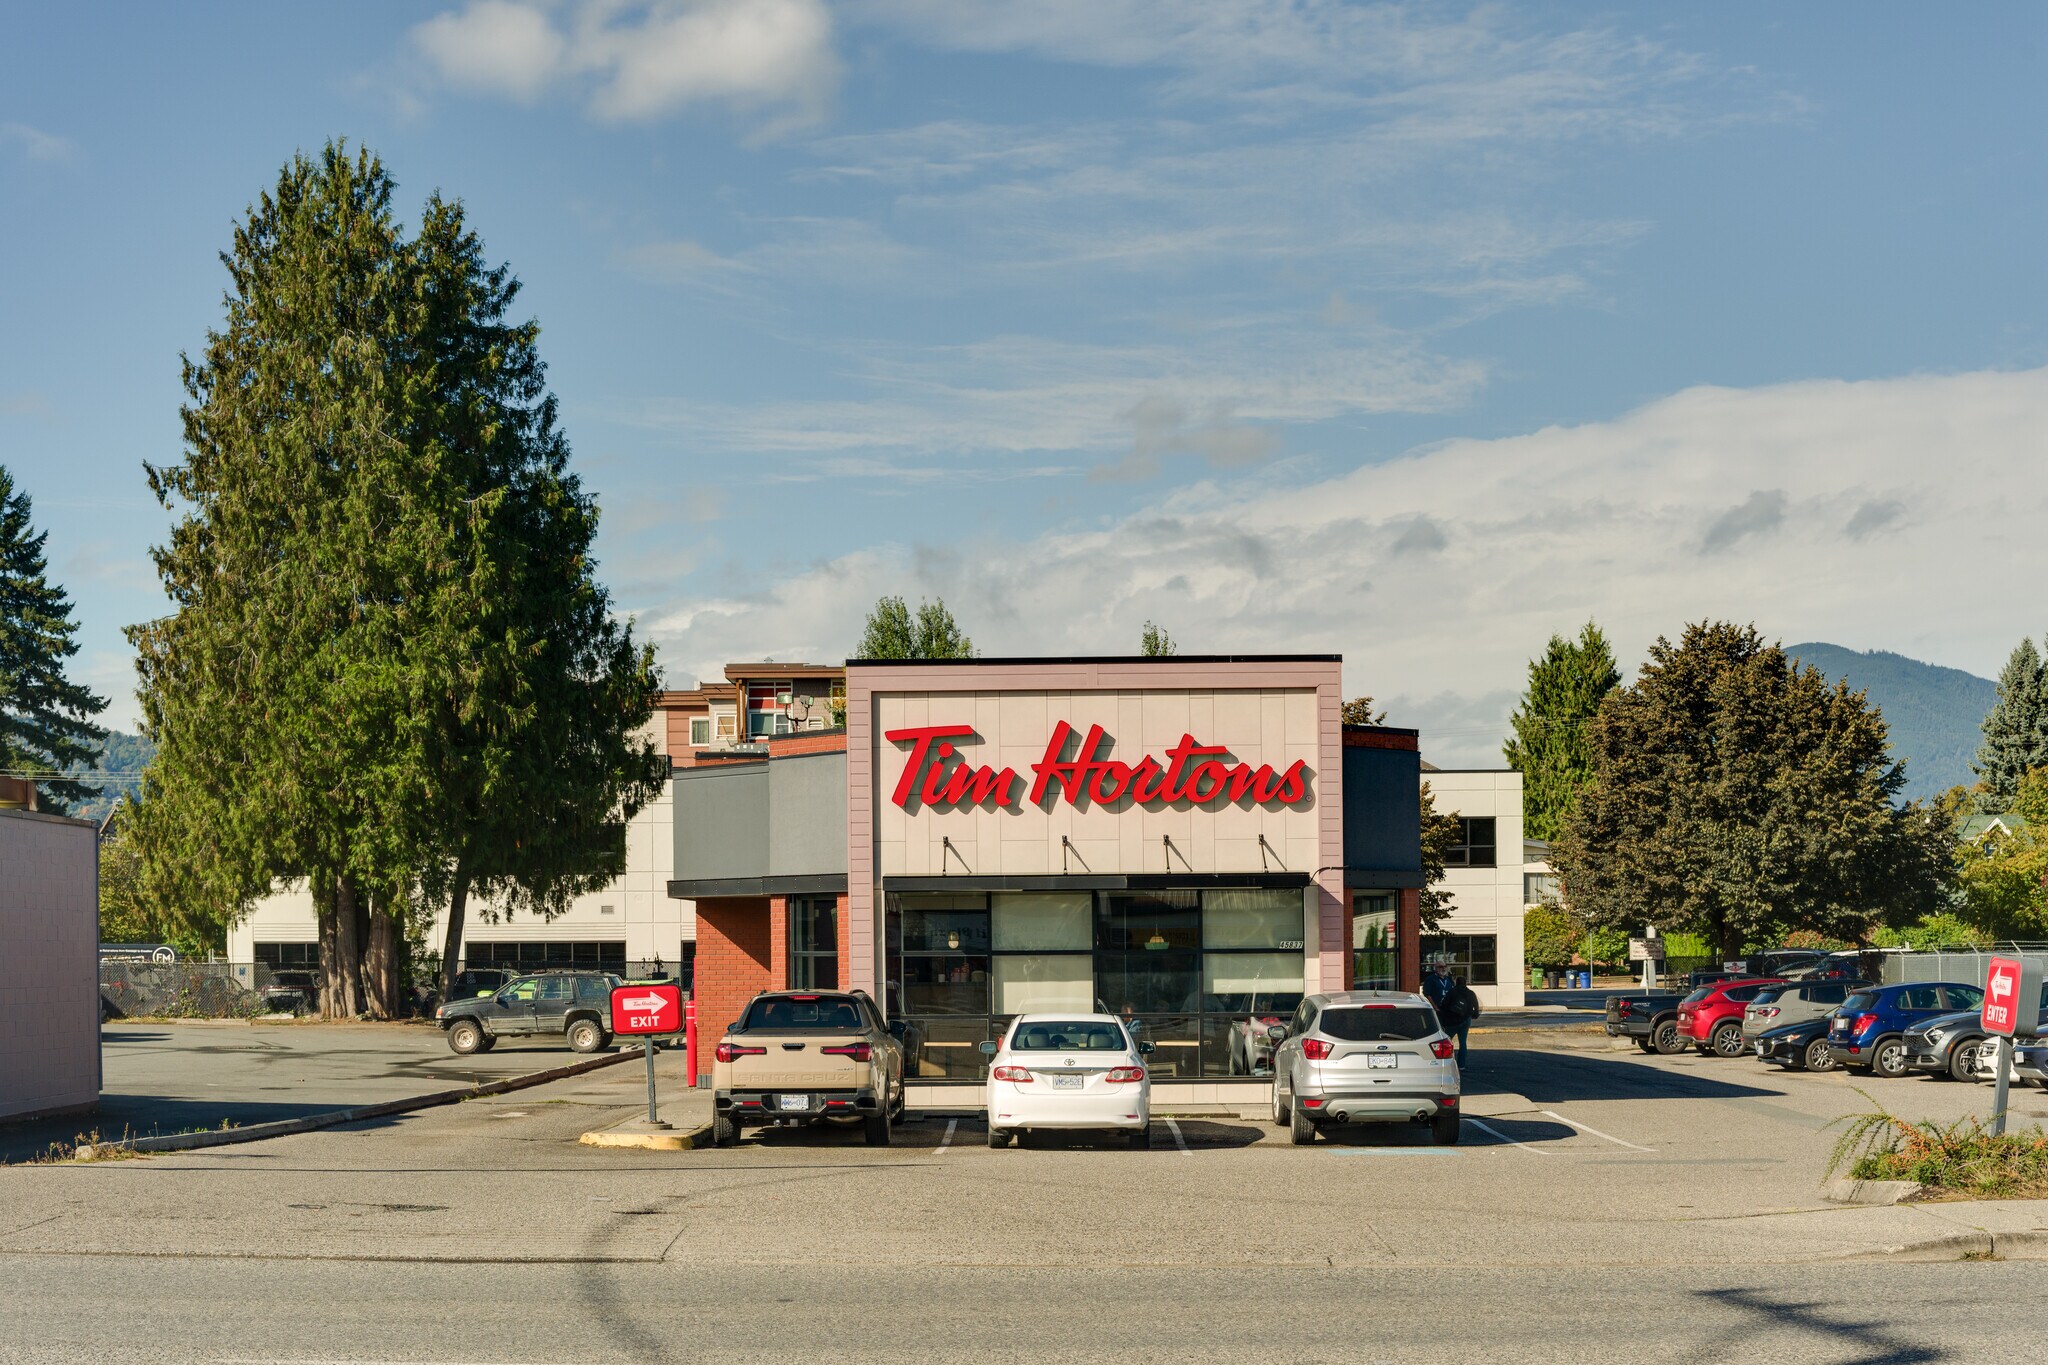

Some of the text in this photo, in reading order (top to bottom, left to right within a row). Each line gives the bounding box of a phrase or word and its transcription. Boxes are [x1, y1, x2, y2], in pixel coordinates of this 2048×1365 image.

[885, 720, 1306, 807] Tim Hortons
[630, 1016, 660, 1028] EXIT
[1986, 1004, 2008, 1024] ENTER
[737, 1073, 849, 1083] SANTA CRUZ
